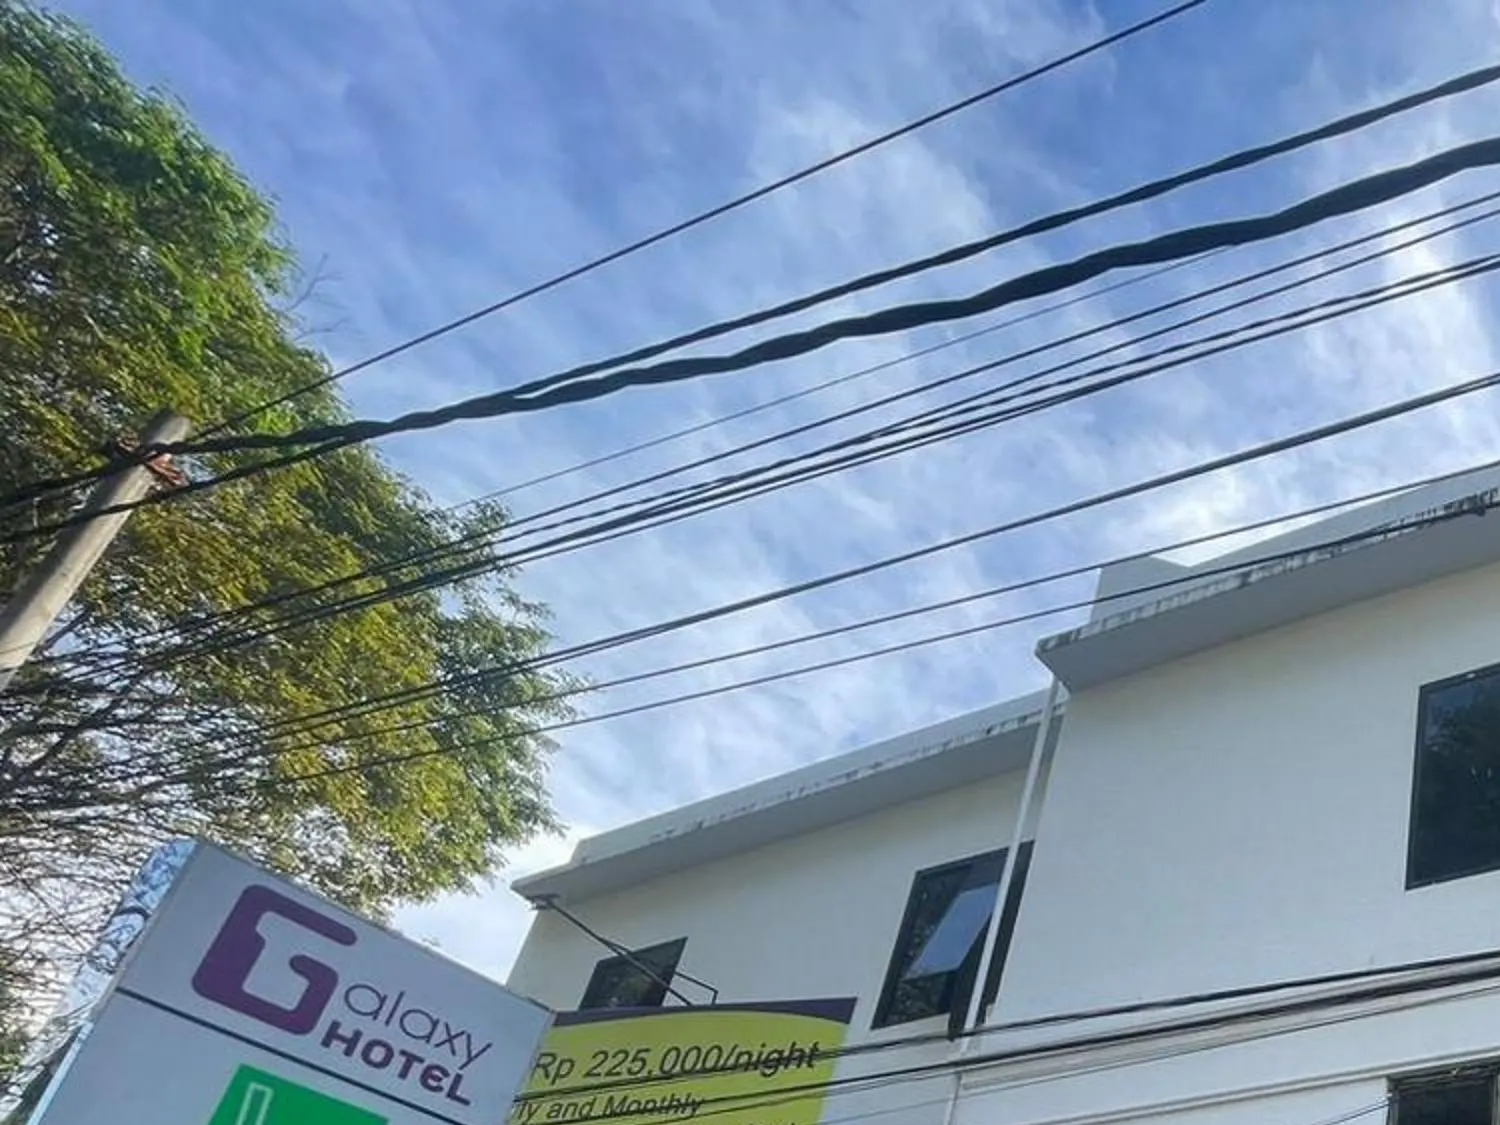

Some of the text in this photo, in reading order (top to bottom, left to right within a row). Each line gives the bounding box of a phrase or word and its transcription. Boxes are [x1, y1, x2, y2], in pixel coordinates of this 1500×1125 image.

[191, 884, 493, 1071] Galaxy
[320, 1020, 472, 1107] HOTEL
[531, 1051, 575, 1085] Rp
[546, 1098, 597, 1120] and
[602, 1093, 705, 1117] Monthly
